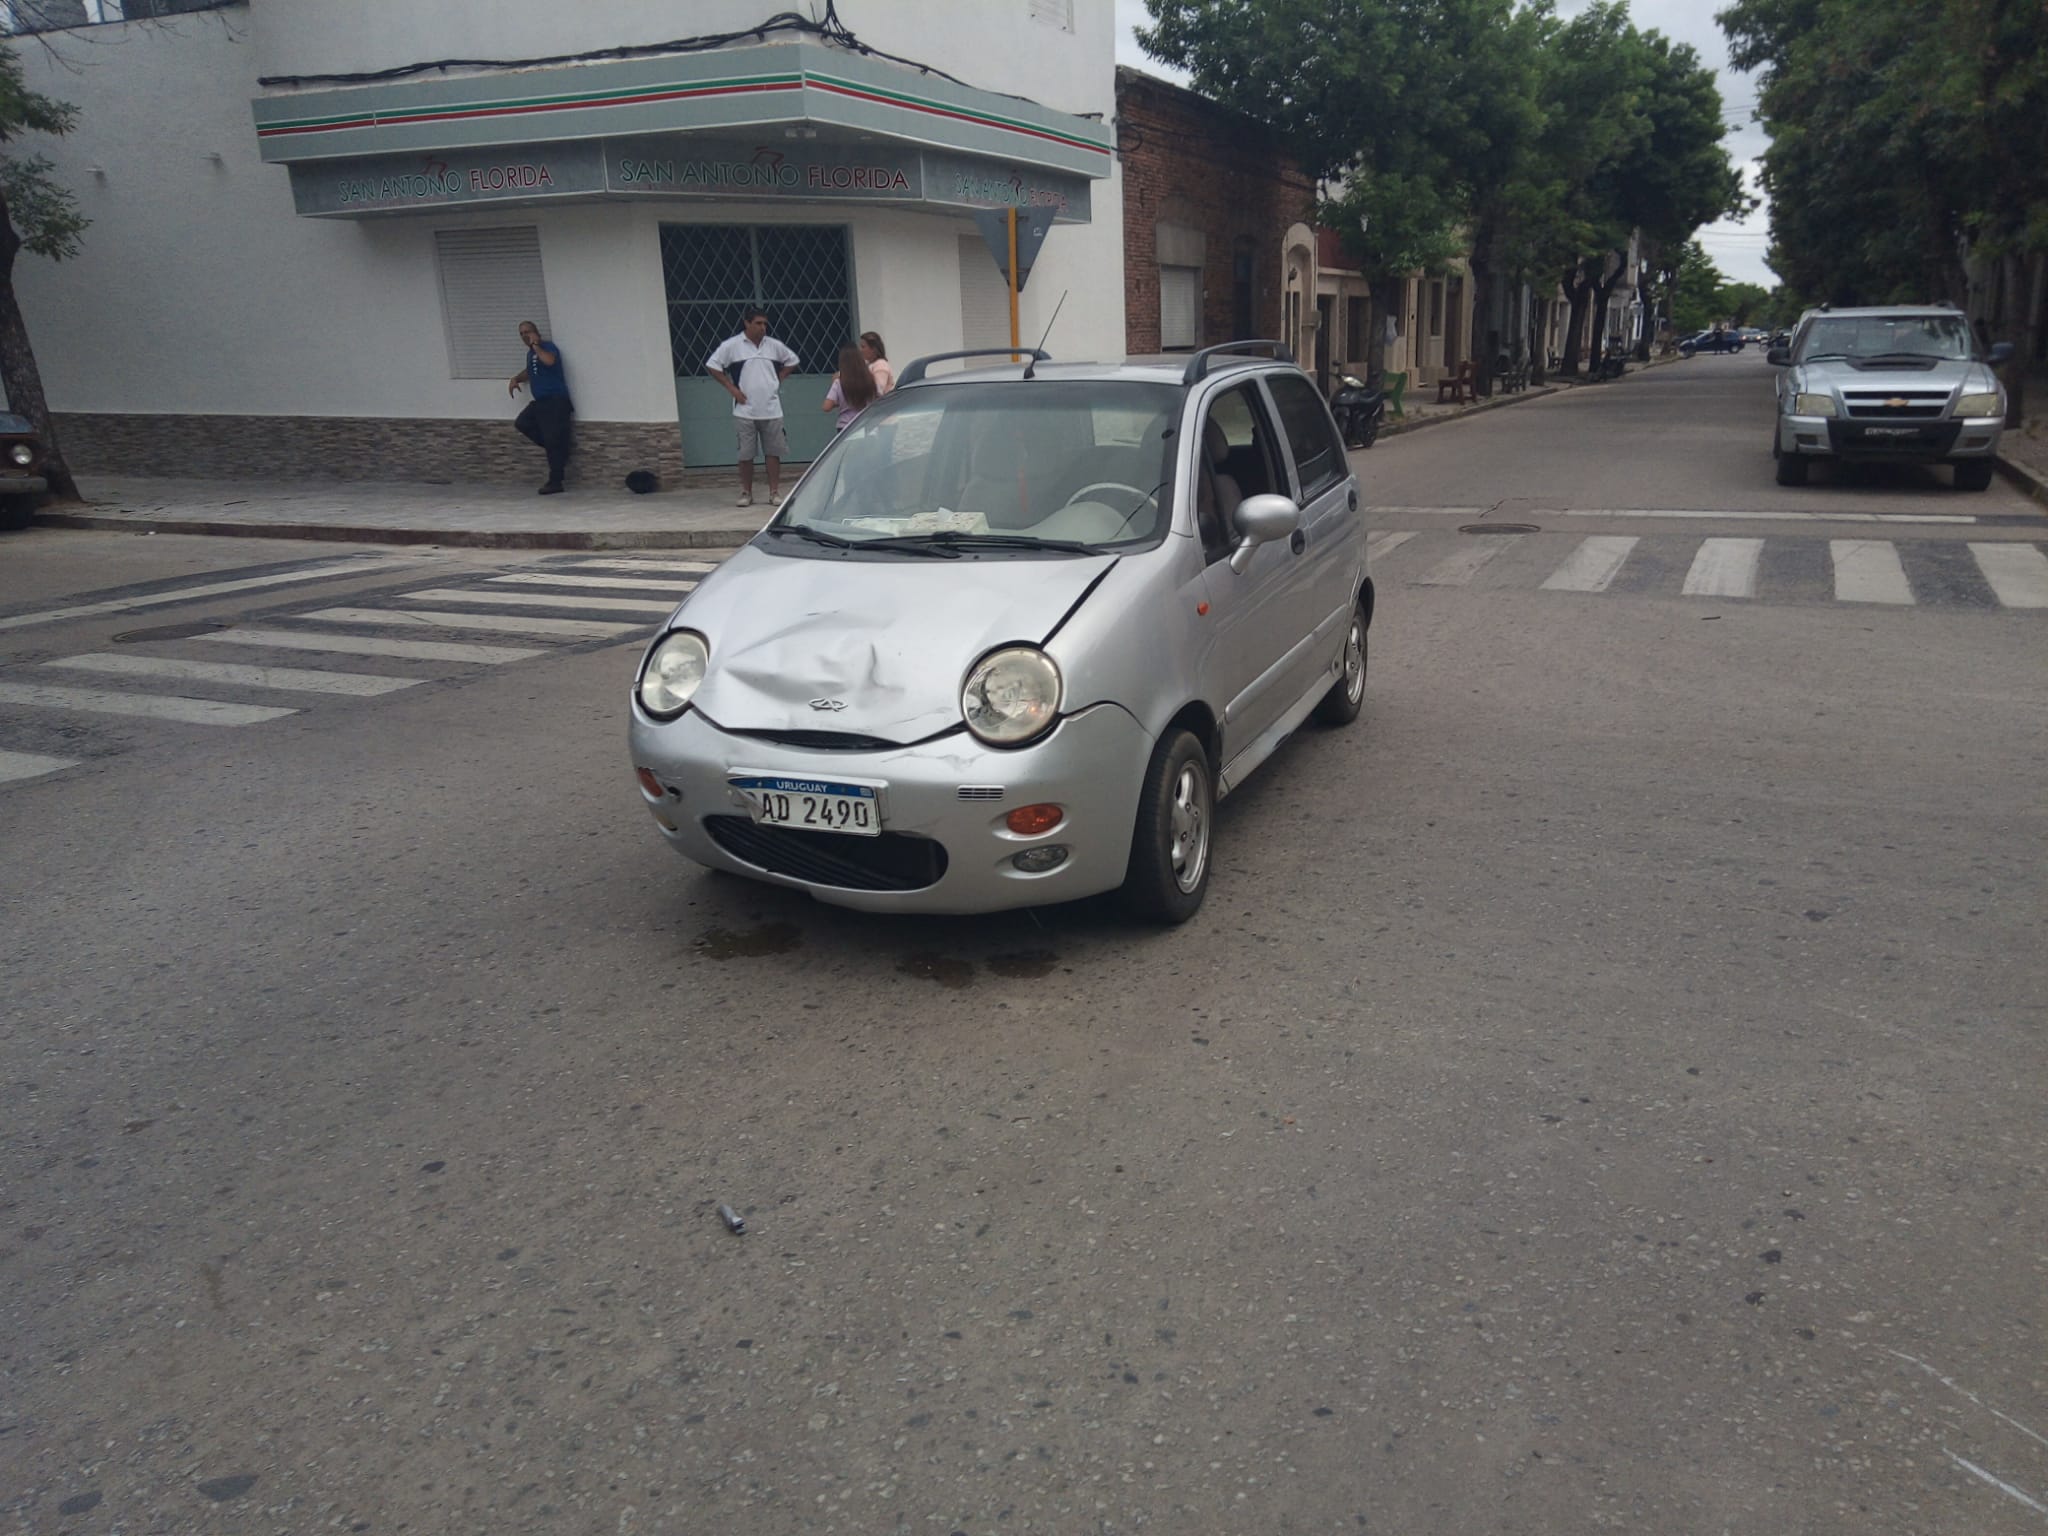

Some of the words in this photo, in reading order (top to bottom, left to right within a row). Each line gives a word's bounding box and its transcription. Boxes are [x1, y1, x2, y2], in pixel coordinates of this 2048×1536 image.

[337, 180, 376, 203] SAN
[380, 170, 462, 200] ANTONIO
[468, 164, 554, 191] FLORIDA
[620, 158, 673, 185] SAN
[682, 160, 800, 187] ANTONIO
[807, 164, 911, 192] FLORIDA
[776, 780, 828, 793] URUGUAY
[747, 791, 790, 820] AD
[803, 796, 869, 828] 2490
